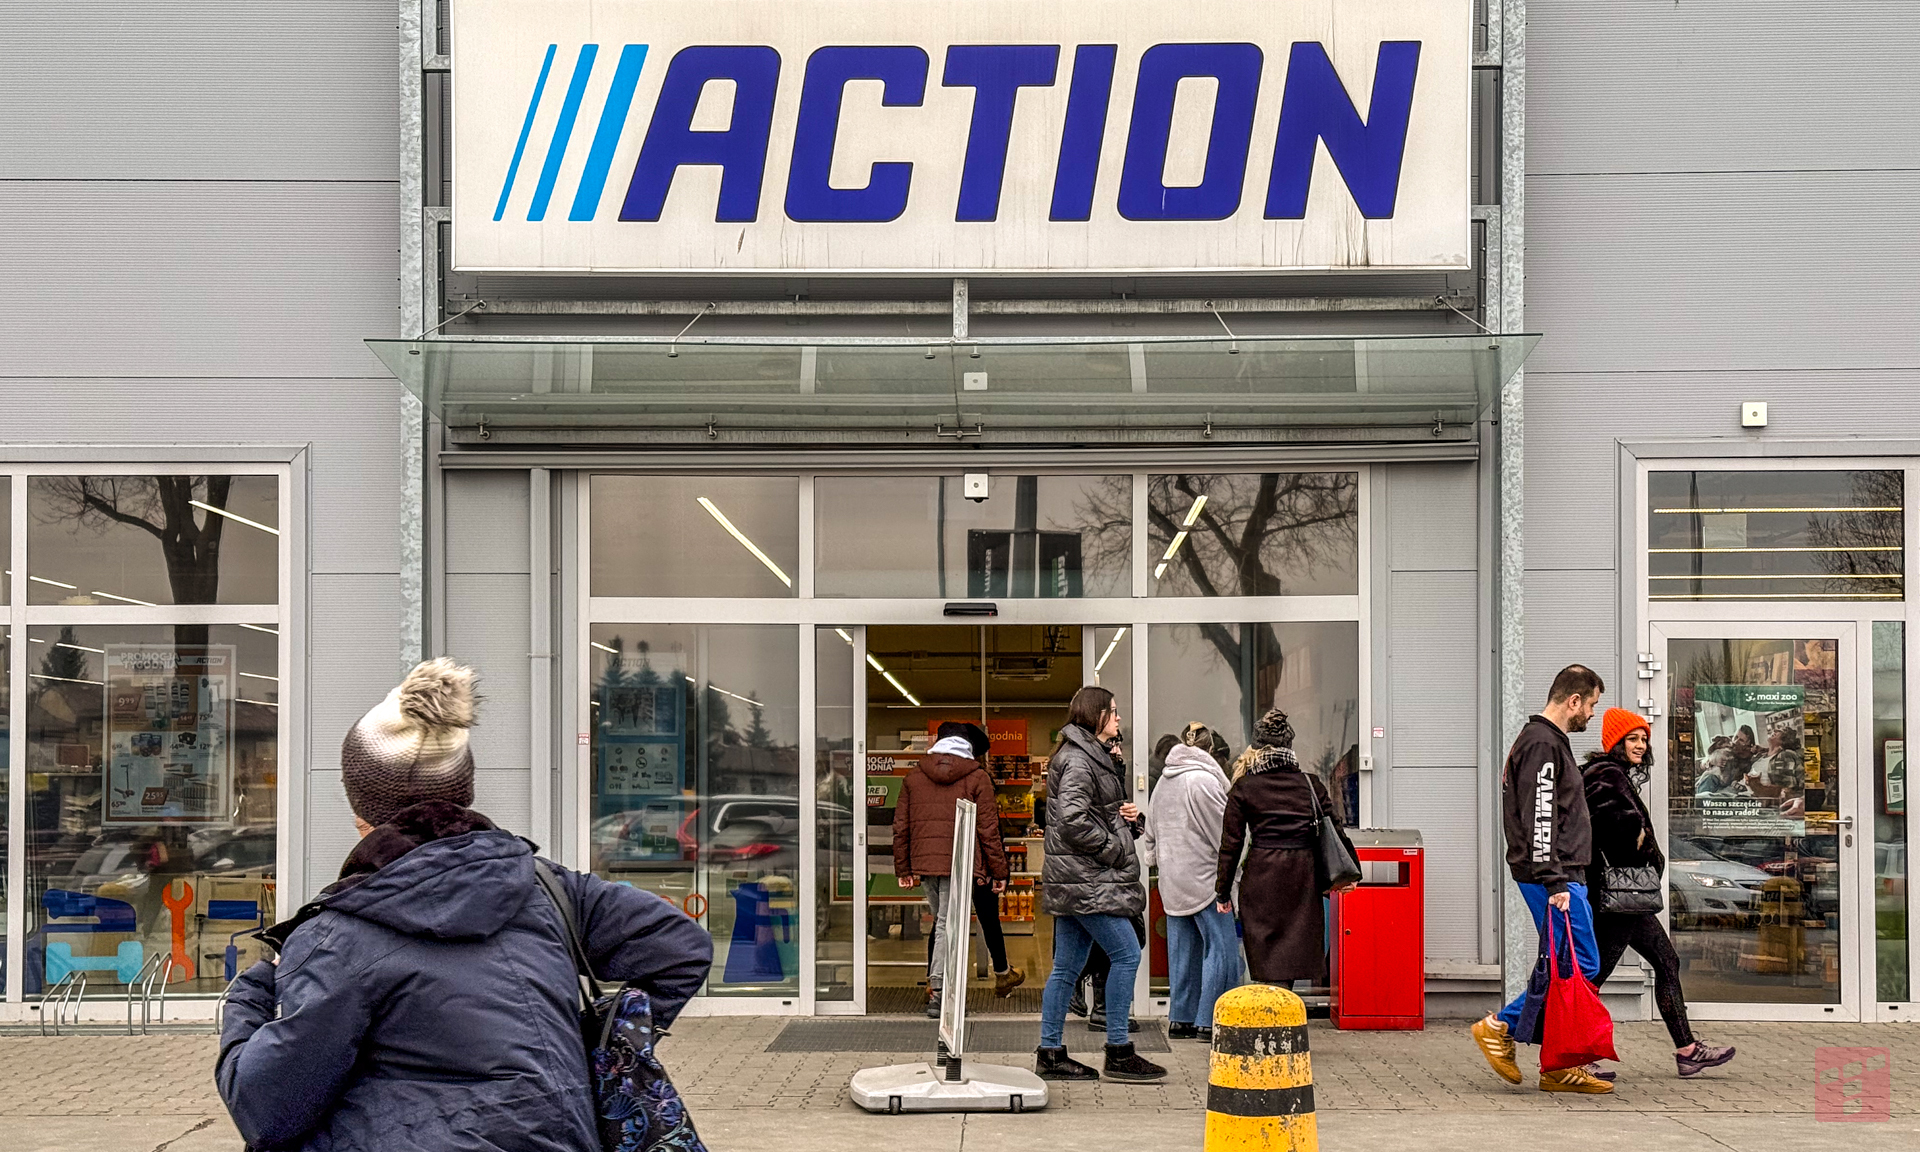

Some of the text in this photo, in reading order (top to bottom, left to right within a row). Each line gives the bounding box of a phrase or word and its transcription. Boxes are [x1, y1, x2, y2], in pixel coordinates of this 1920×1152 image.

[618, 41, 1422, 222] ACTION
[121, 652, 180, 661] PROMOCJA
[122, 660, 179, 669] TYGODNIA
[1757, 692, 1798, 701] maxi zoo
[1702, 800, 1762, 809] Wasze szczęście
[1532, 762, 1555, 863] SAMURAI
[1734, 808, 1760, 816] radość
